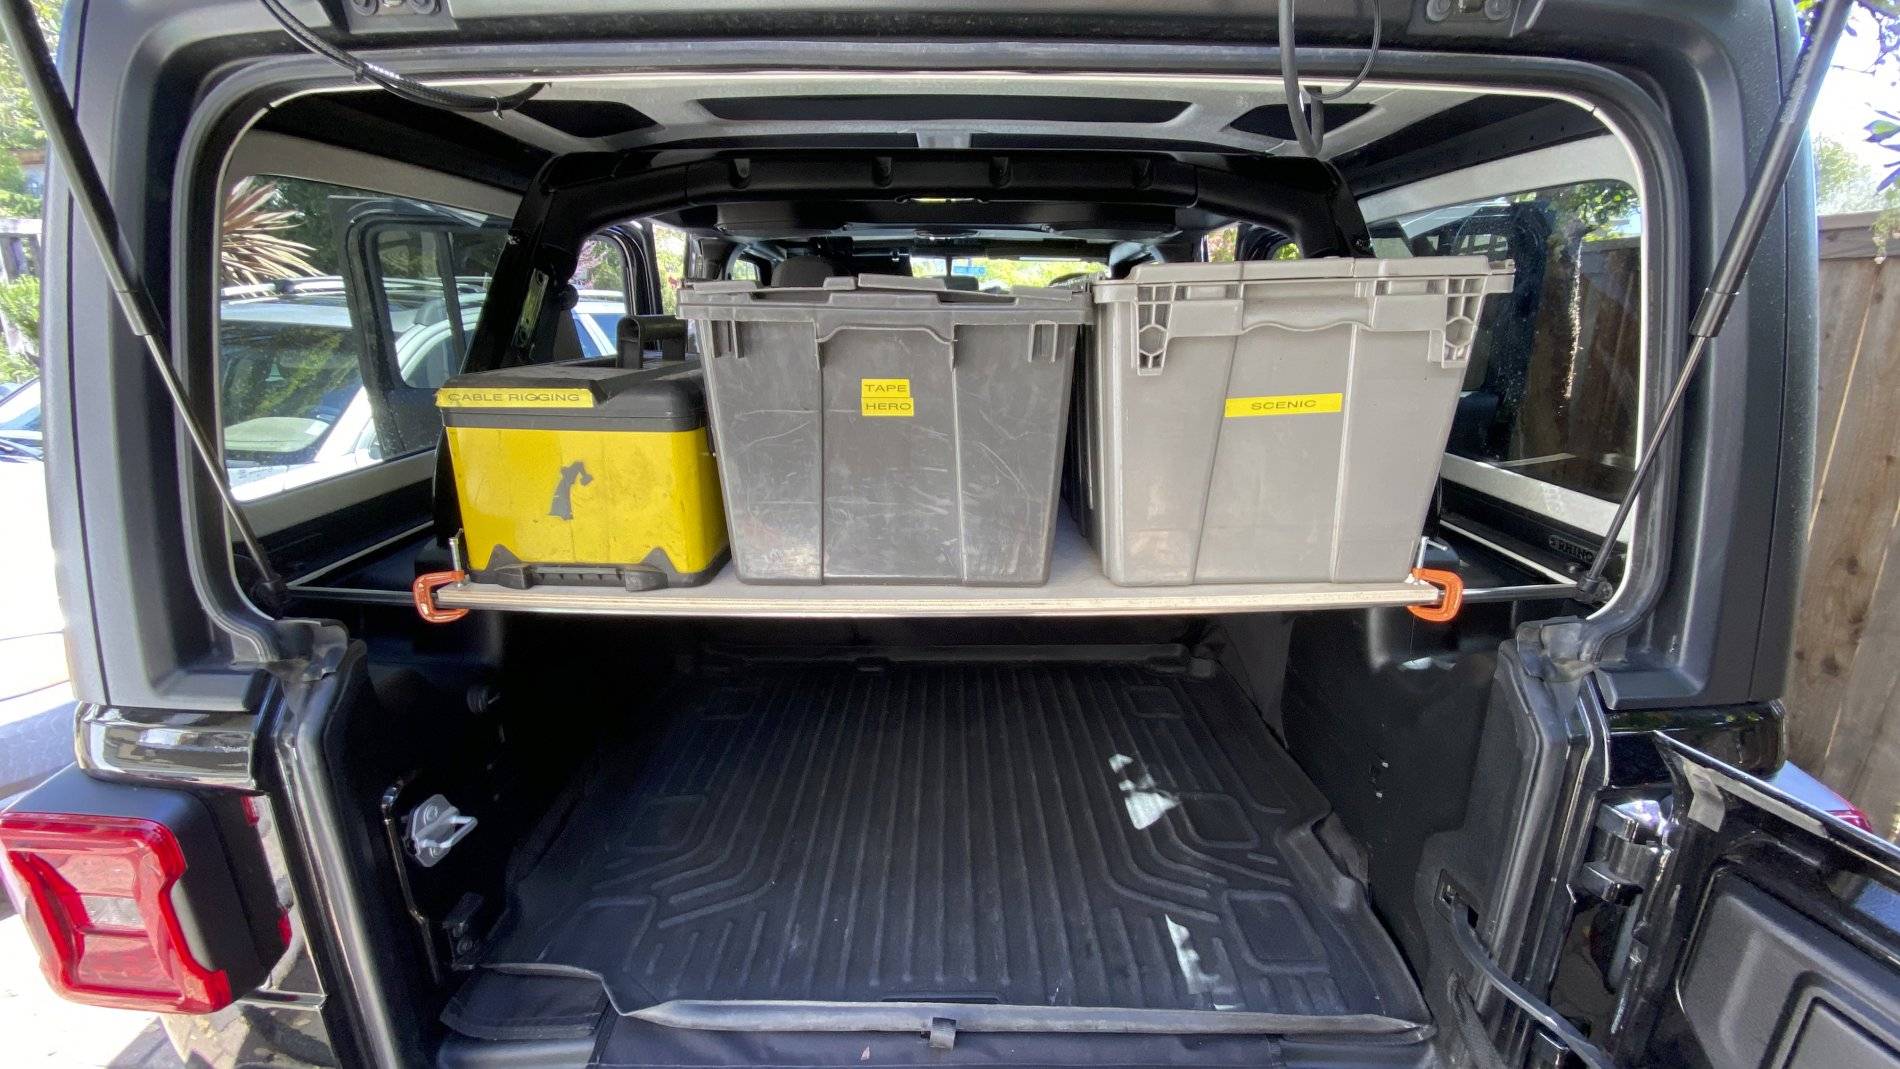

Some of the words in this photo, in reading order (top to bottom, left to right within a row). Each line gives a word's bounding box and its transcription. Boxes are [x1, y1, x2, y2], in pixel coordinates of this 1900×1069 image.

[864, 384, 908, 393] TAPE
[447, 392, 503, 402] CABLE
[508, 393, 580, 402] RIGGING
[865, 402, 912, 411] HERO
[1251, 400, 1317, 411] SCENIC
